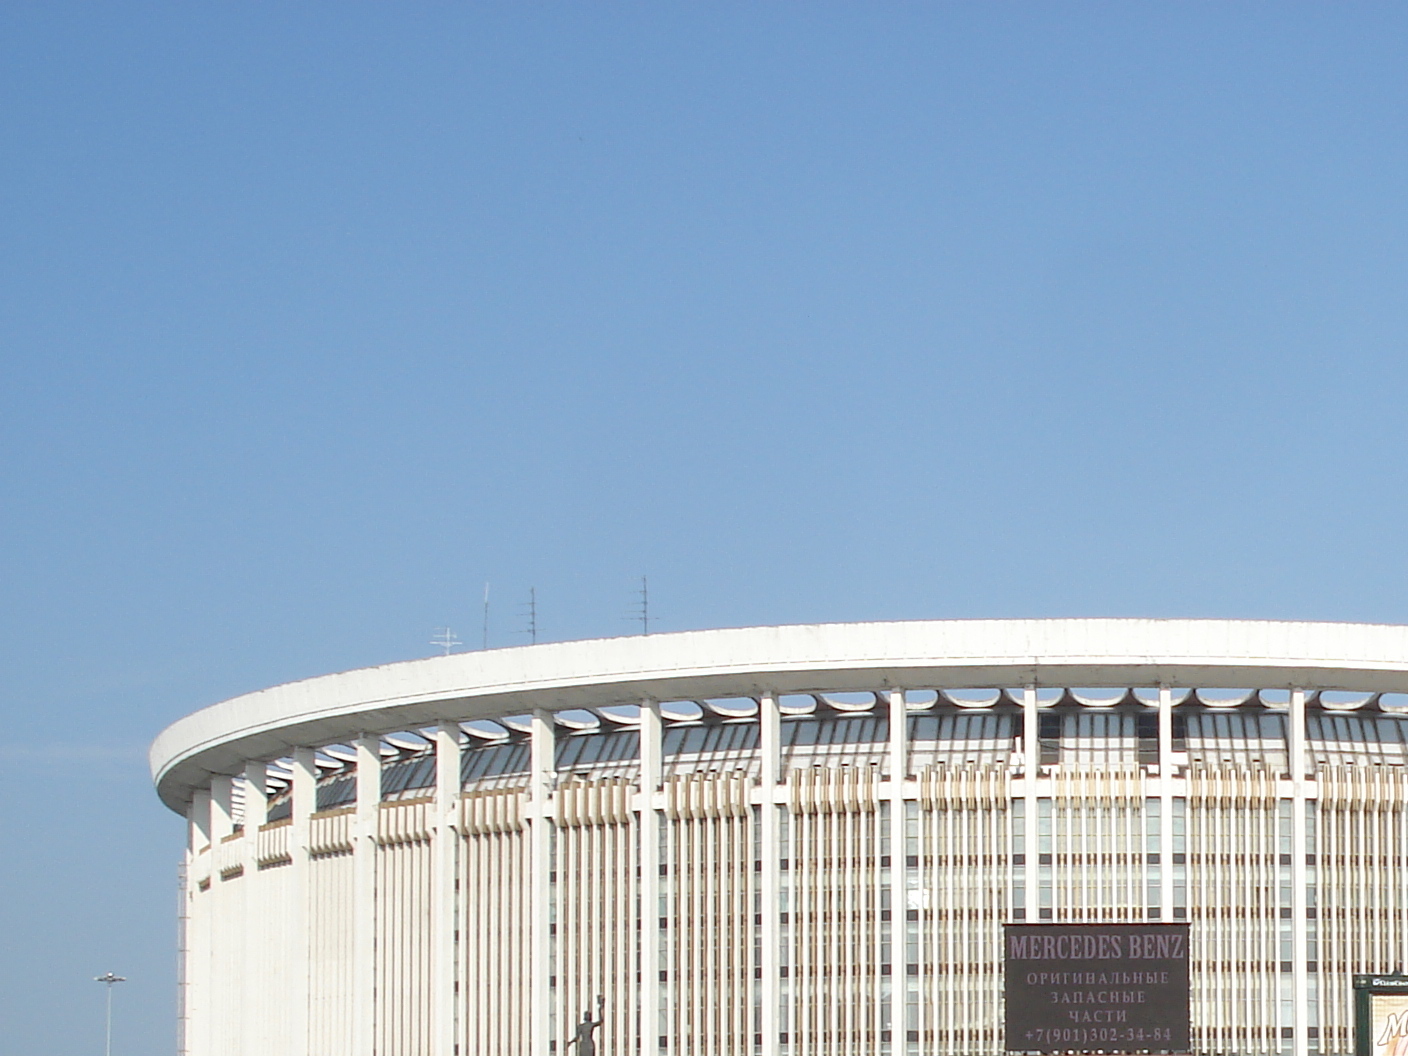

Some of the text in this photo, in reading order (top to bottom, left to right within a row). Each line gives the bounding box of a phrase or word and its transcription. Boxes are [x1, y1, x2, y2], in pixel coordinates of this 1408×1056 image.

[1010, 934, 1184, 960] MERCEDES BENZ
[1026, 972, 1169, 985] ОРИГИНАЛЬНЫЕ
[1051, 991, 1145, 1004] ЗАПАСНЫЕ
[1069, 1010, 1127, 1023] ЧАСТИ
[1025, 1028, 1172, 1044] +7(901)302-34-84
